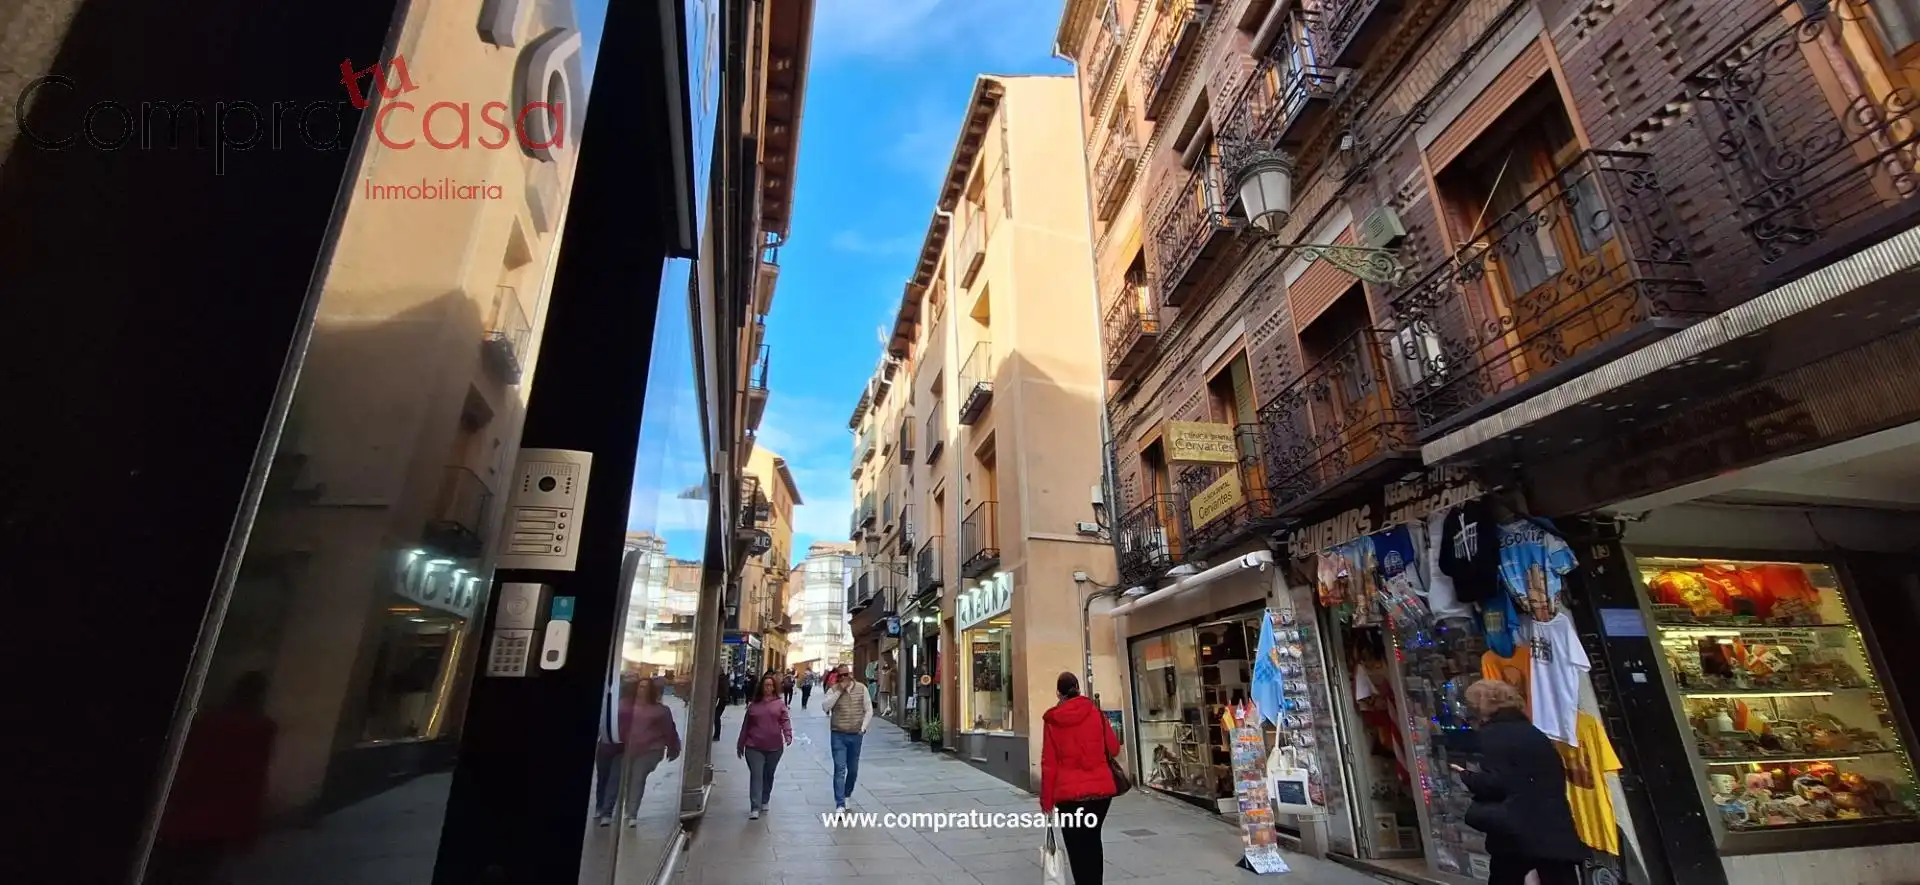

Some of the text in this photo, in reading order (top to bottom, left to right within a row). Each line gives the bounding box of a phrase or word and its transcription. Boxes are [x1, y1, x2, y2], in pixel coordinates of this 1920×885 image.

[1175, 439, 1234, 452] Cervantes
[1199, 490, 1233, 519] Cervantes
[1288, 504, 1372, 559] SOUVENIRS
[1500, 529, 1546, 549] EGOVIA
